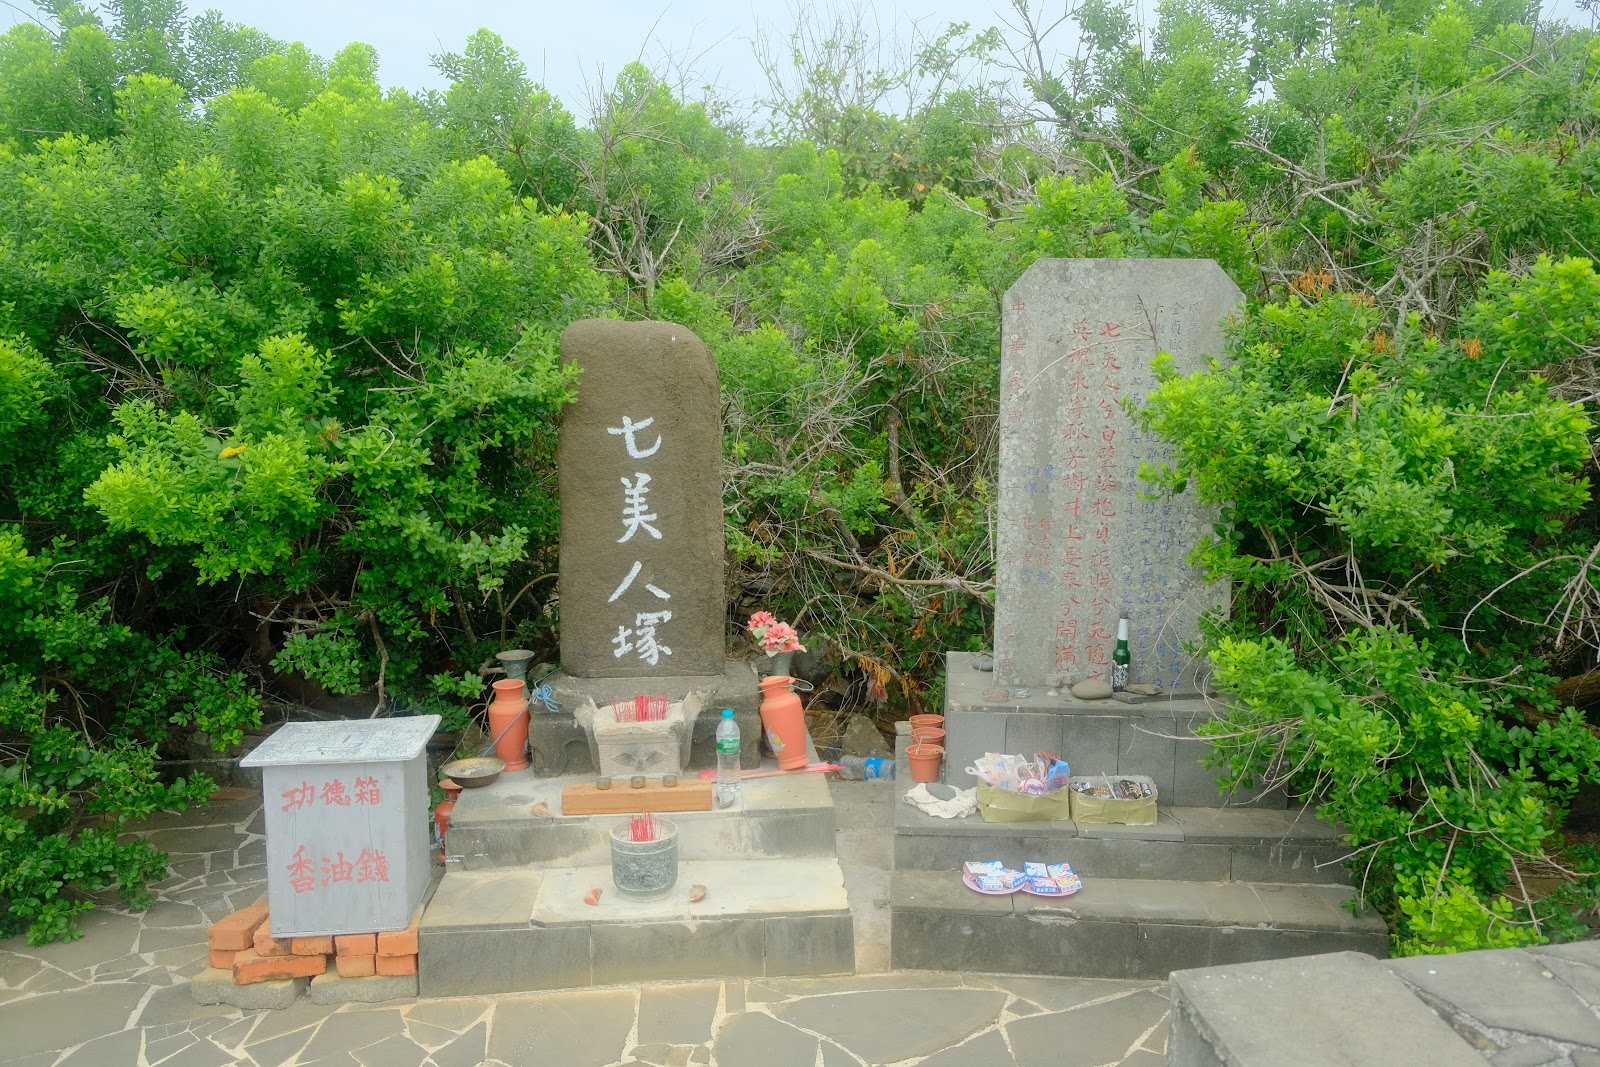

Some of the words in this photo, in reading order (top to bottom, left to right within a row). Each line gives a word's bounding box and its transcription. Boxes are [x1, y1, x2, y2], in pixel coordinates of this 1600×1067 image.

[606, 415, 673, 666] 七美人塚
[281, 776, 381, 812] 功德箱
[286, 844, 390, 894] 香油錢
